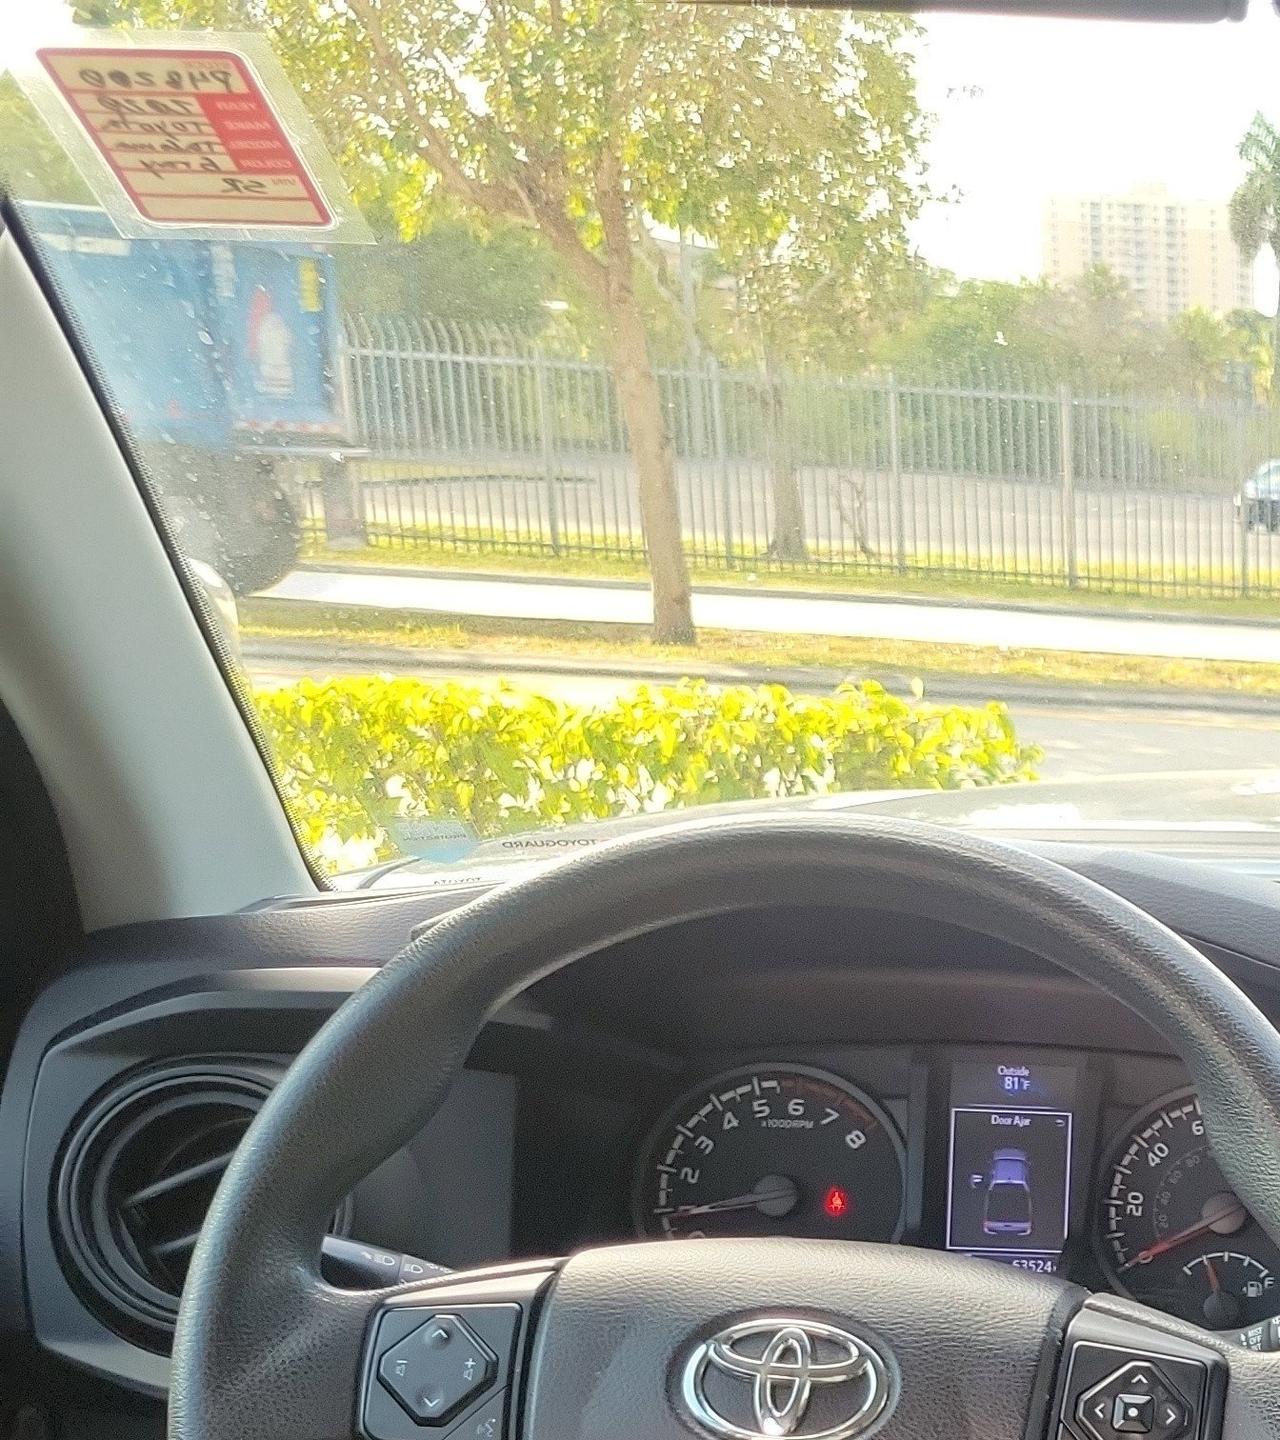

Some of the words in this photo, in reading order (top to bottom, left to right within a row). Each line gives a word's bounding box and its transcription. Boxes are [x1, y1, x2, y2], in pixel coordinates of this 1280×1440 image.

[997, 1065, 1030, 1077] Outside
[752, 1099, 771, 1118] 5
[787, 1098, 805, 1116] 6
[820, 1108, 840, 1125] 7
[722, 1111, 740, 1130] 4
[991, 1114, 1015, 1126] Door
[1014, 1115, 1032, 1127] Ajar
[694, 1135, 715, 1155] 3
[845, 1129, 867, 1149] 8
[1147, 1142, 1169, 1167] 40
[680, 1166, 700, 1184] 2
[1126, 1191, 1144, 1216] 20
